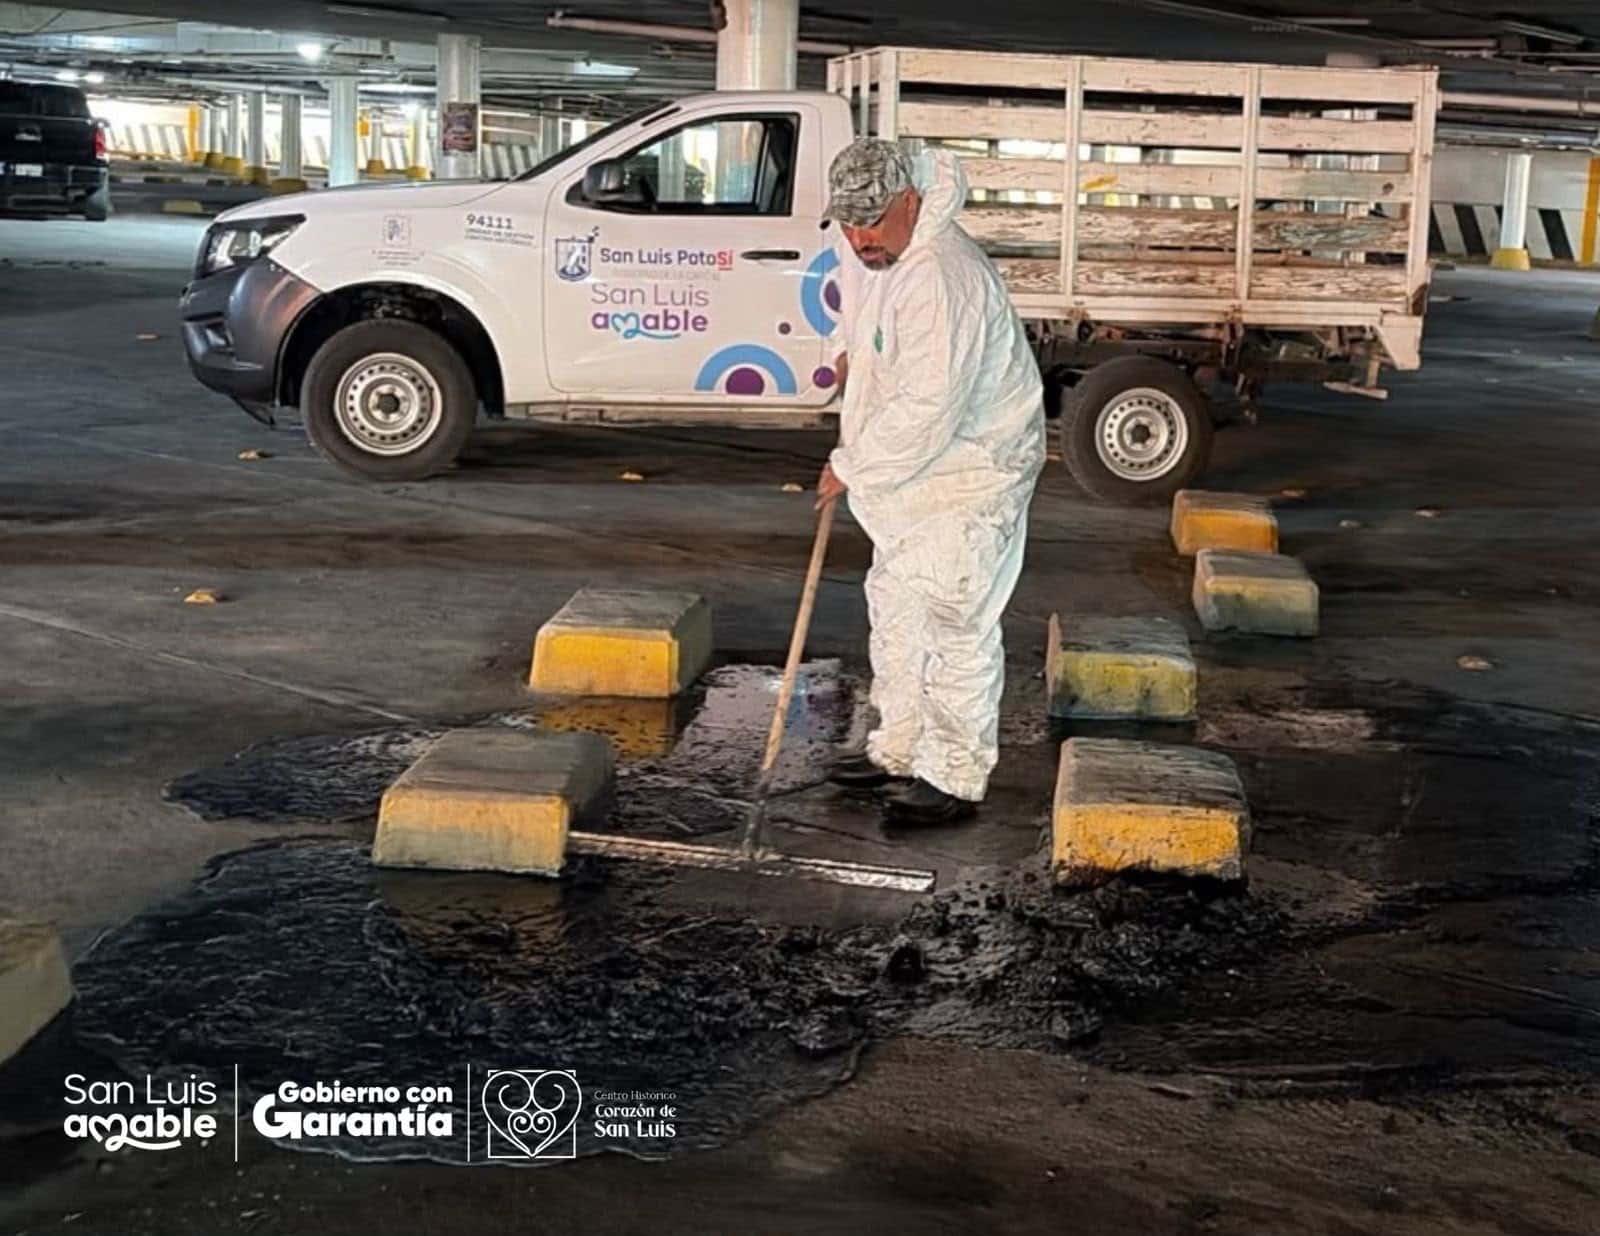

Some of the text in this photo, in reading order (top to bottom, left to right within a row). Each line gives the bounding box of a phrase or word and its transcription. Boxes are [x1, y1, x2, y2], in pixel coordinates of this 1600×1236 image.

[466, 213, 513, 229] 94111
[600, 248, 634, 264] San
[638, 248, 673, 265] Luis
[591, 282, 710, 307] San Luis
[591, 309, 709, 340] amable
